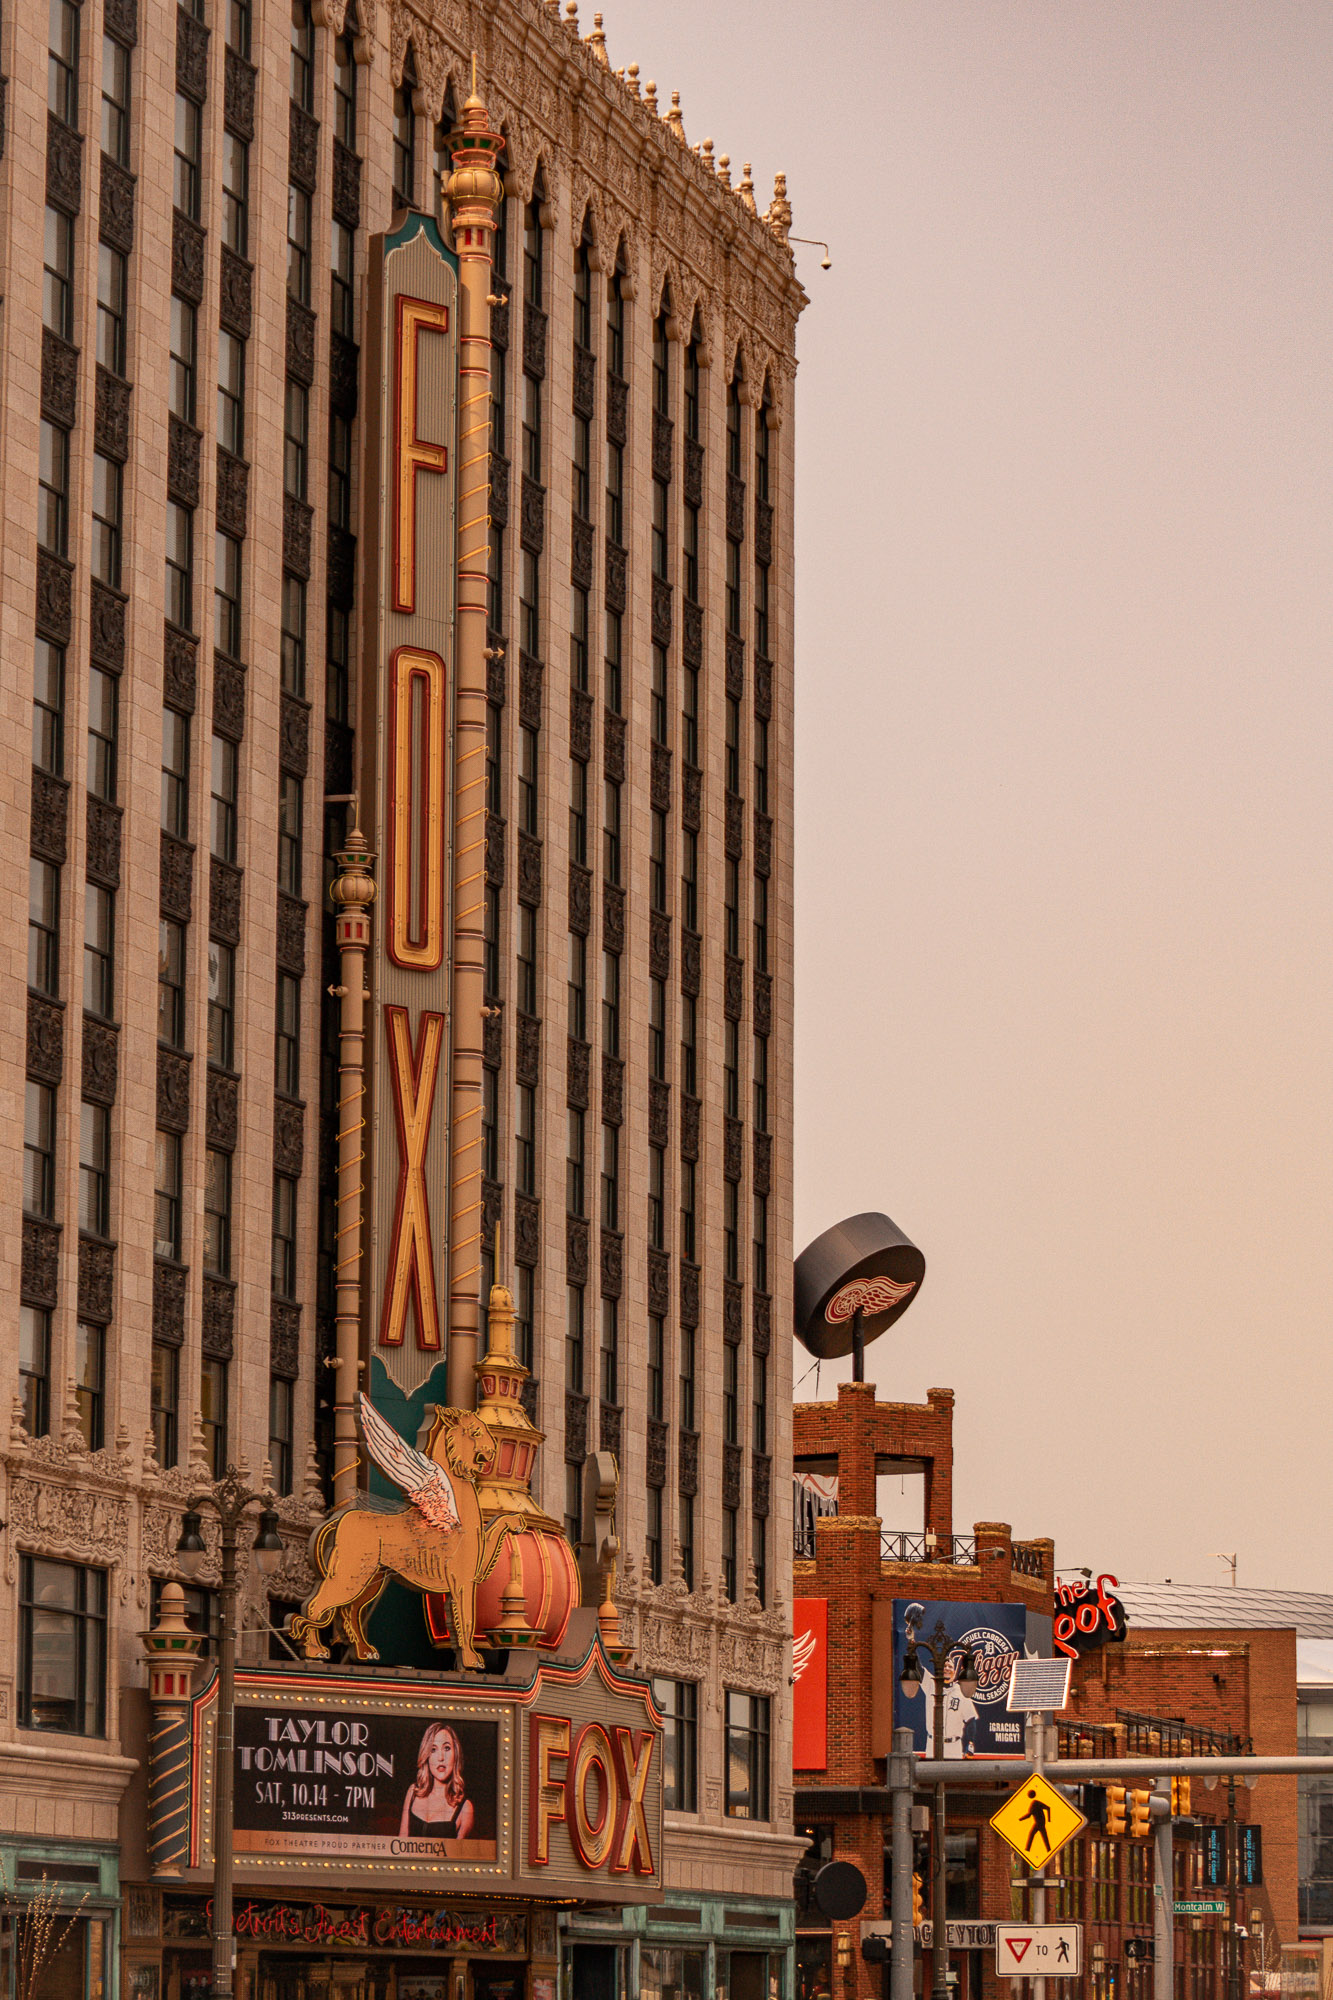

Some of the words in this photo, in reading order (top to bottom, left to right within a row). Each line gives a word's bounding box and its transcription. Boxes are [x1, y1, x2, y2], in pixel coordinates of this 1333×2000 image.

[379, 293, 448, 1351] FOX
[1054, 1576, 1089, 1608] he
[982, 1631, 1009, 1654] CABRERA
[986, 1681, 1009, 1699] SEASON
[264, 1717, 369, 1747] TAYLOR
[995, 1733, 1020, 1743] MIGGY!
[237, 1746, 394, 1778] TOMLINSON
[255, 1781, 285, 1808] SAT,
[292, 1783, 327, 1807] 10.14
[345, 1785, 375, 1809] 7PM
[528, 1712, 656, 1876] FOX
[282, 1811, 349, 1823] 313PRESENTS.COM
[265, 1838, 280, 1846] FOX
[284, 1839, 318, 1848] THEATRE
[321, 1841, 348, 1849] PROUD
[352, 1842, 386, 1850] PARTNER
[1174, 1902, 1213, 1911] Montcalm
[1215, 1903, 1224, 1911] W
[375, 1910, 498, 1947] Entertainment
[1035, 1945, 1048, 1956] TO
